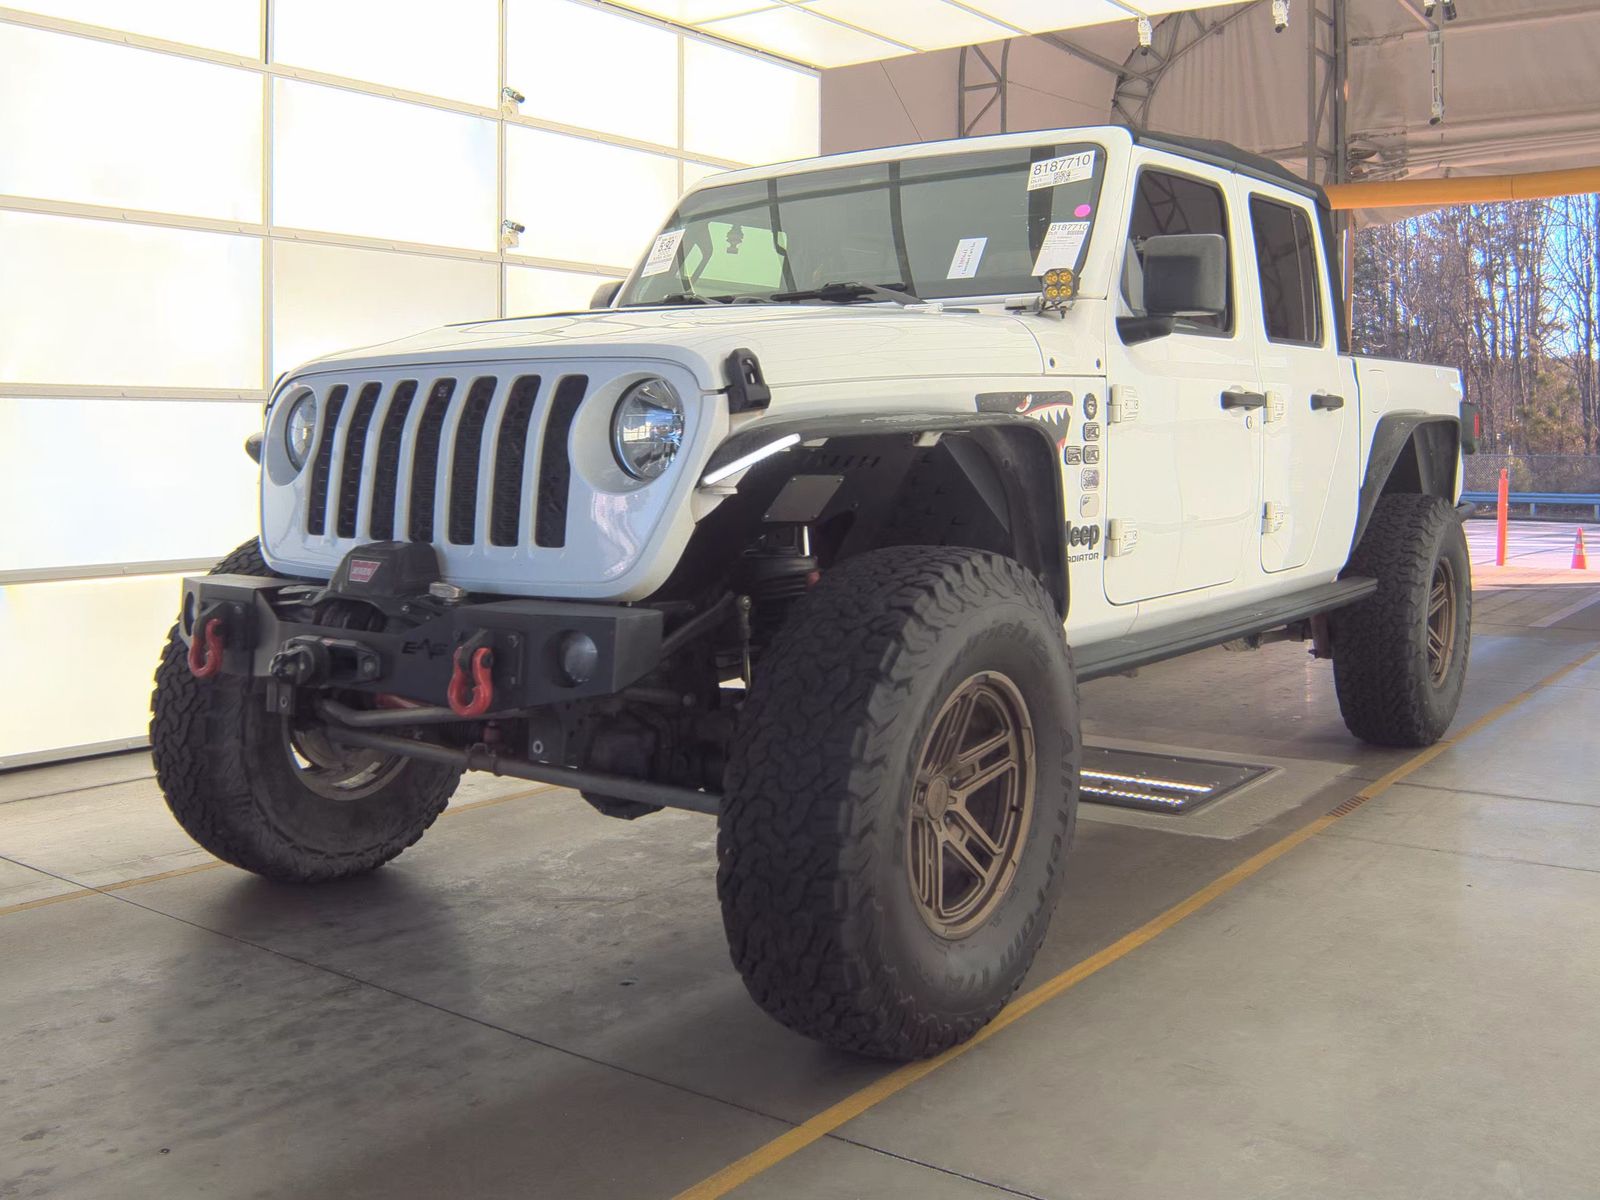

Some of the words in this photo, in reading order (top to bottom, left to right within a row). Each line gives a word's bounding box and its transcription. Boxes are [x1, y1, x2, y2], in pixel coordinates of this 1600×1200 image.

[1033, 154, 1091, 176] 8187710
[1050, 223, 1089, 232] 8187710
[1067, 552, 1099, 563] ADIATOR
